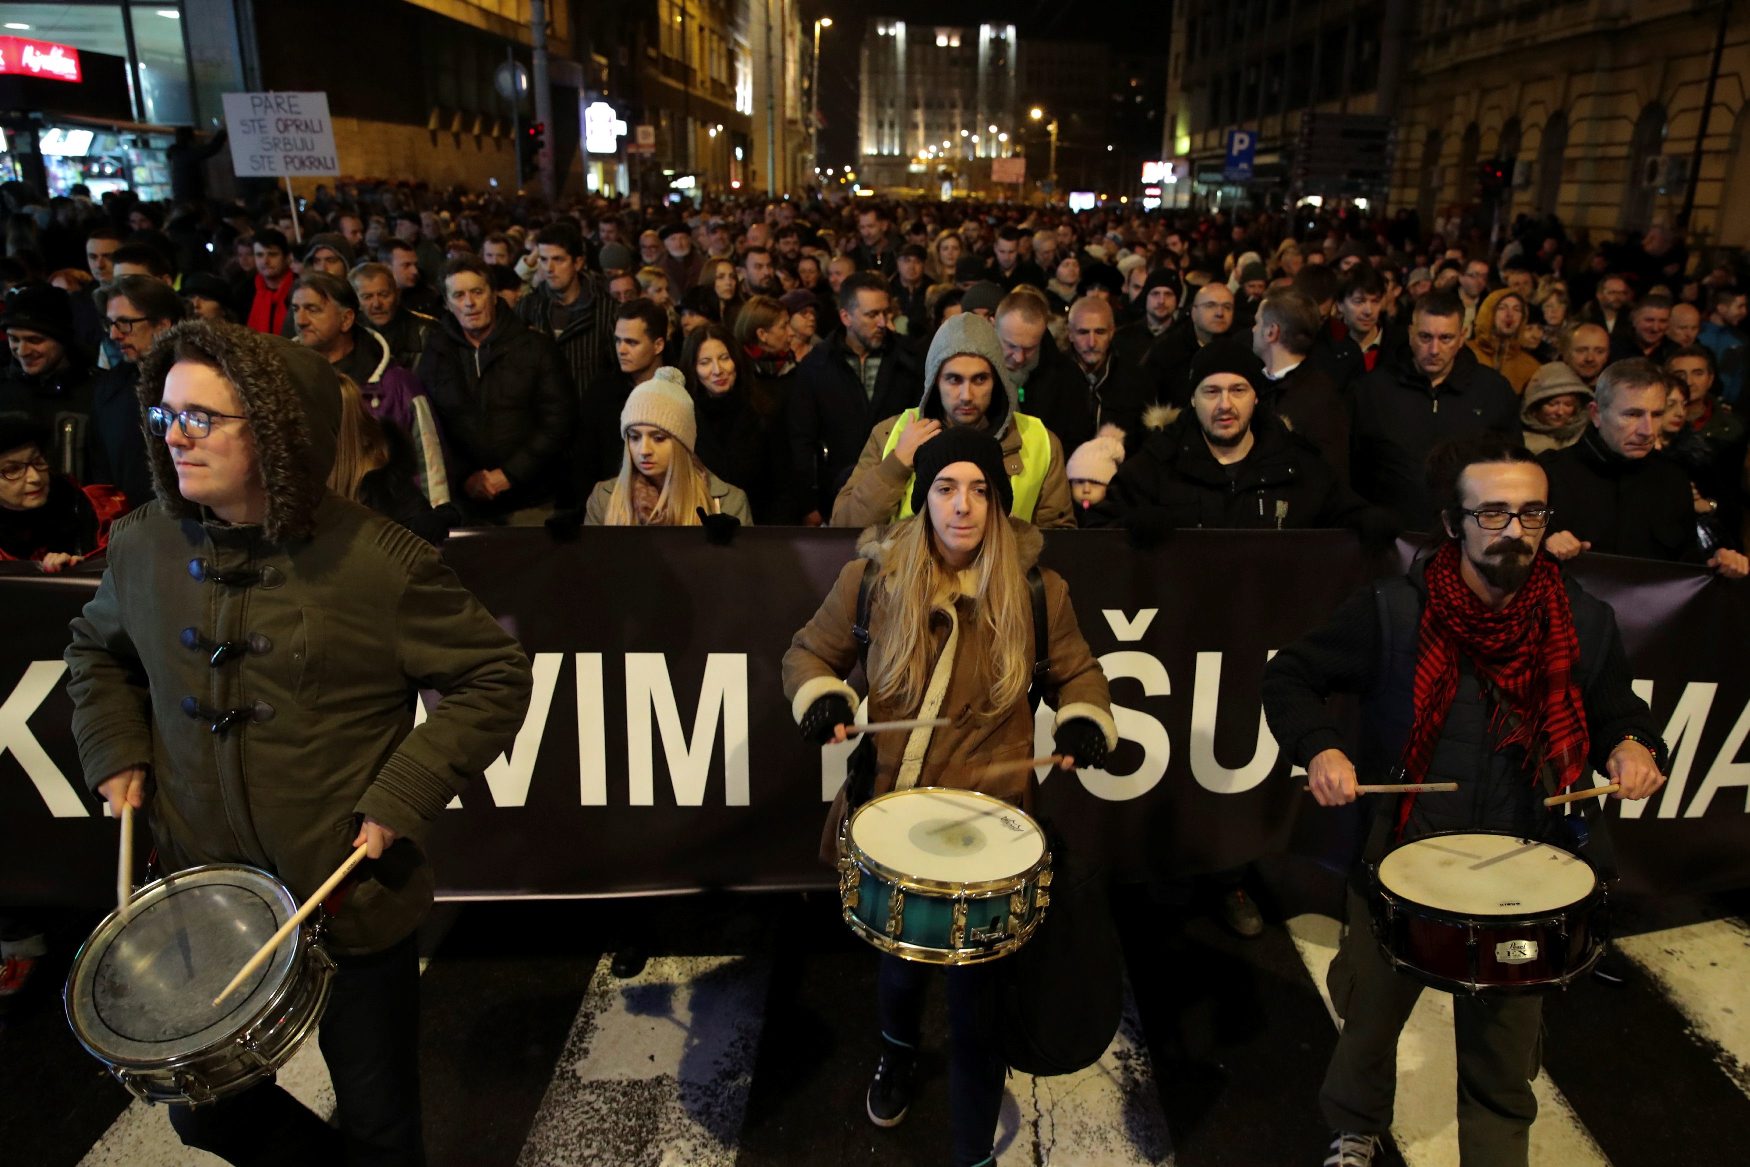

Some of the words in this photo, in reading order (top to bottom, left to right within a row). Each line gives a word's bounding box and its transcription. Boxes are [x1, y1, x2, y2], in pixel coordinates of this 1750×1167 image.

[250, 94, 302, 116] PARE
[240, 118, 268, 135] STE
[275, 118, 323, 134] OPRALI
[1231, 132, 1251, 157] P
[249, 154, 277, 171] STE
[283, 154, 336, 172] POKRALI
